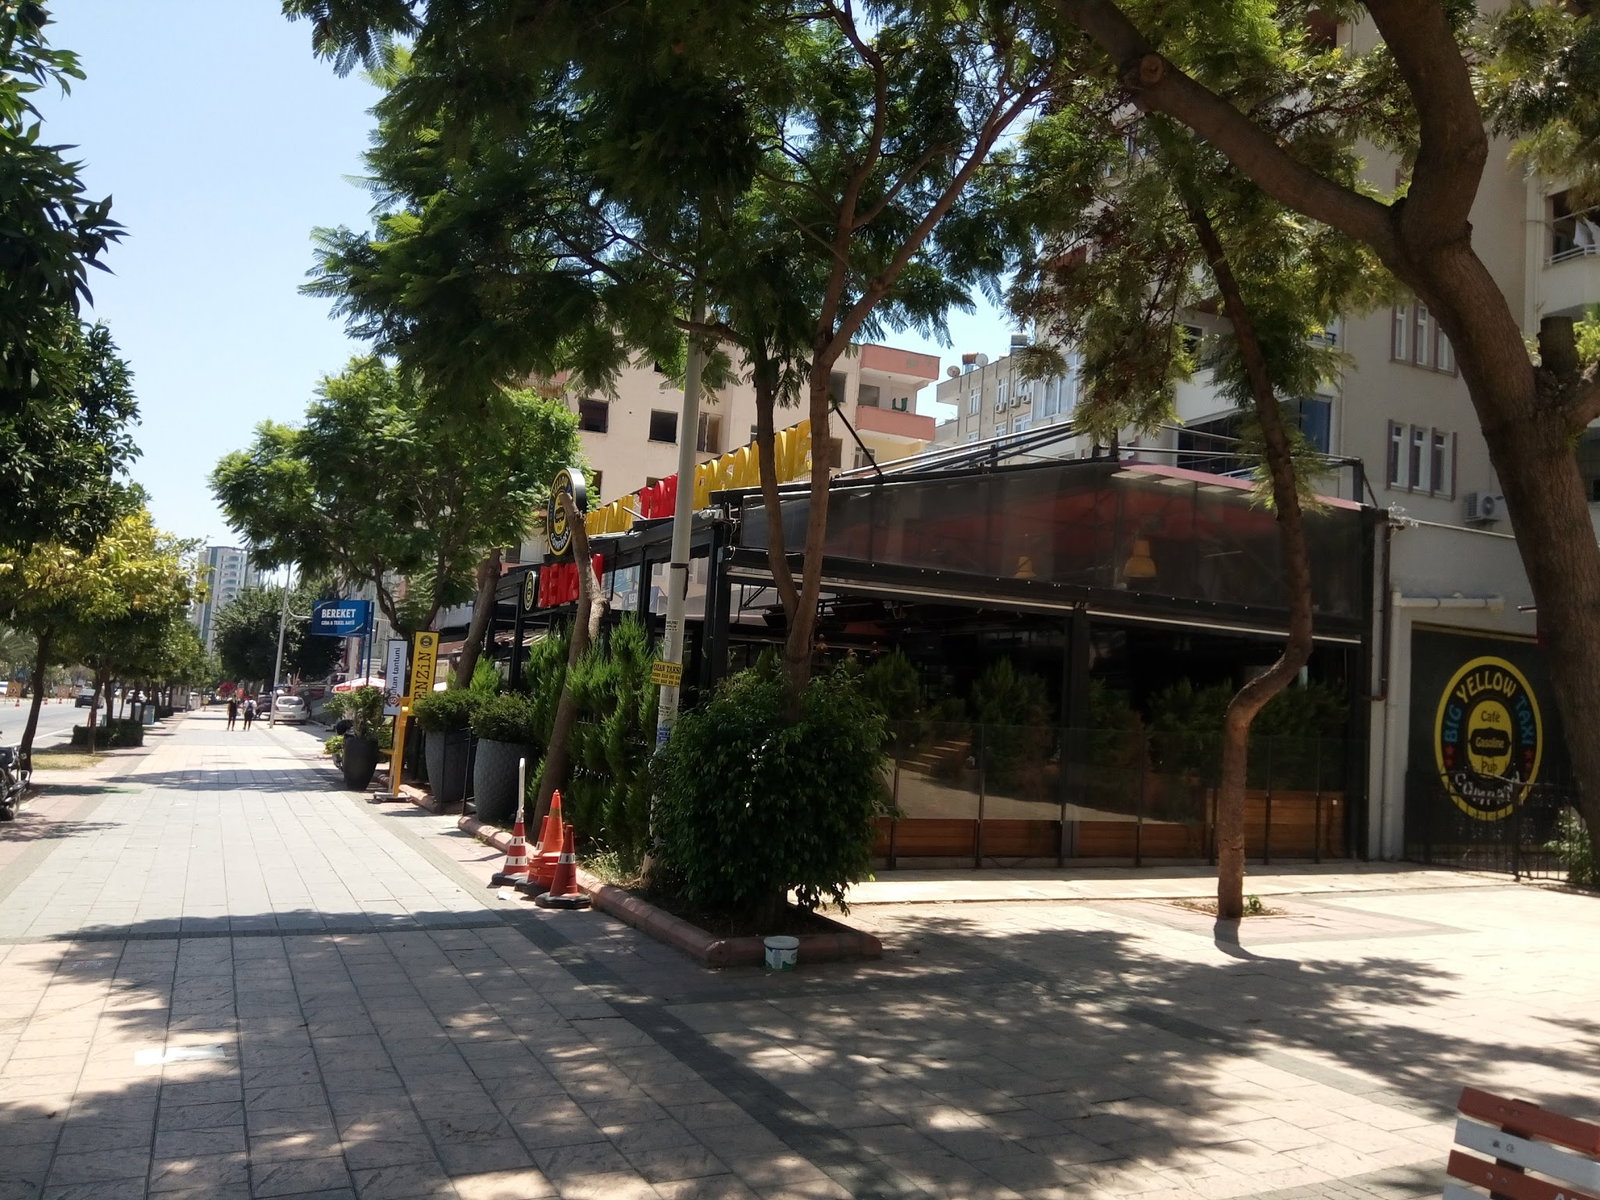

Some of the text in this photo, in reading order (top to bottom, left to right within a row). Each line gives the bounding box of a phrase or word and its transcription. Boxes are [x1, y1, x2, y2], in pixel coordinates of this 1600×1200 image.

[322, 609, 356, 618] BEREKET
[1444, 670, 1534, 744] BIG YELLOW TAXI
[1481, 760, 1498, 773] Pub
